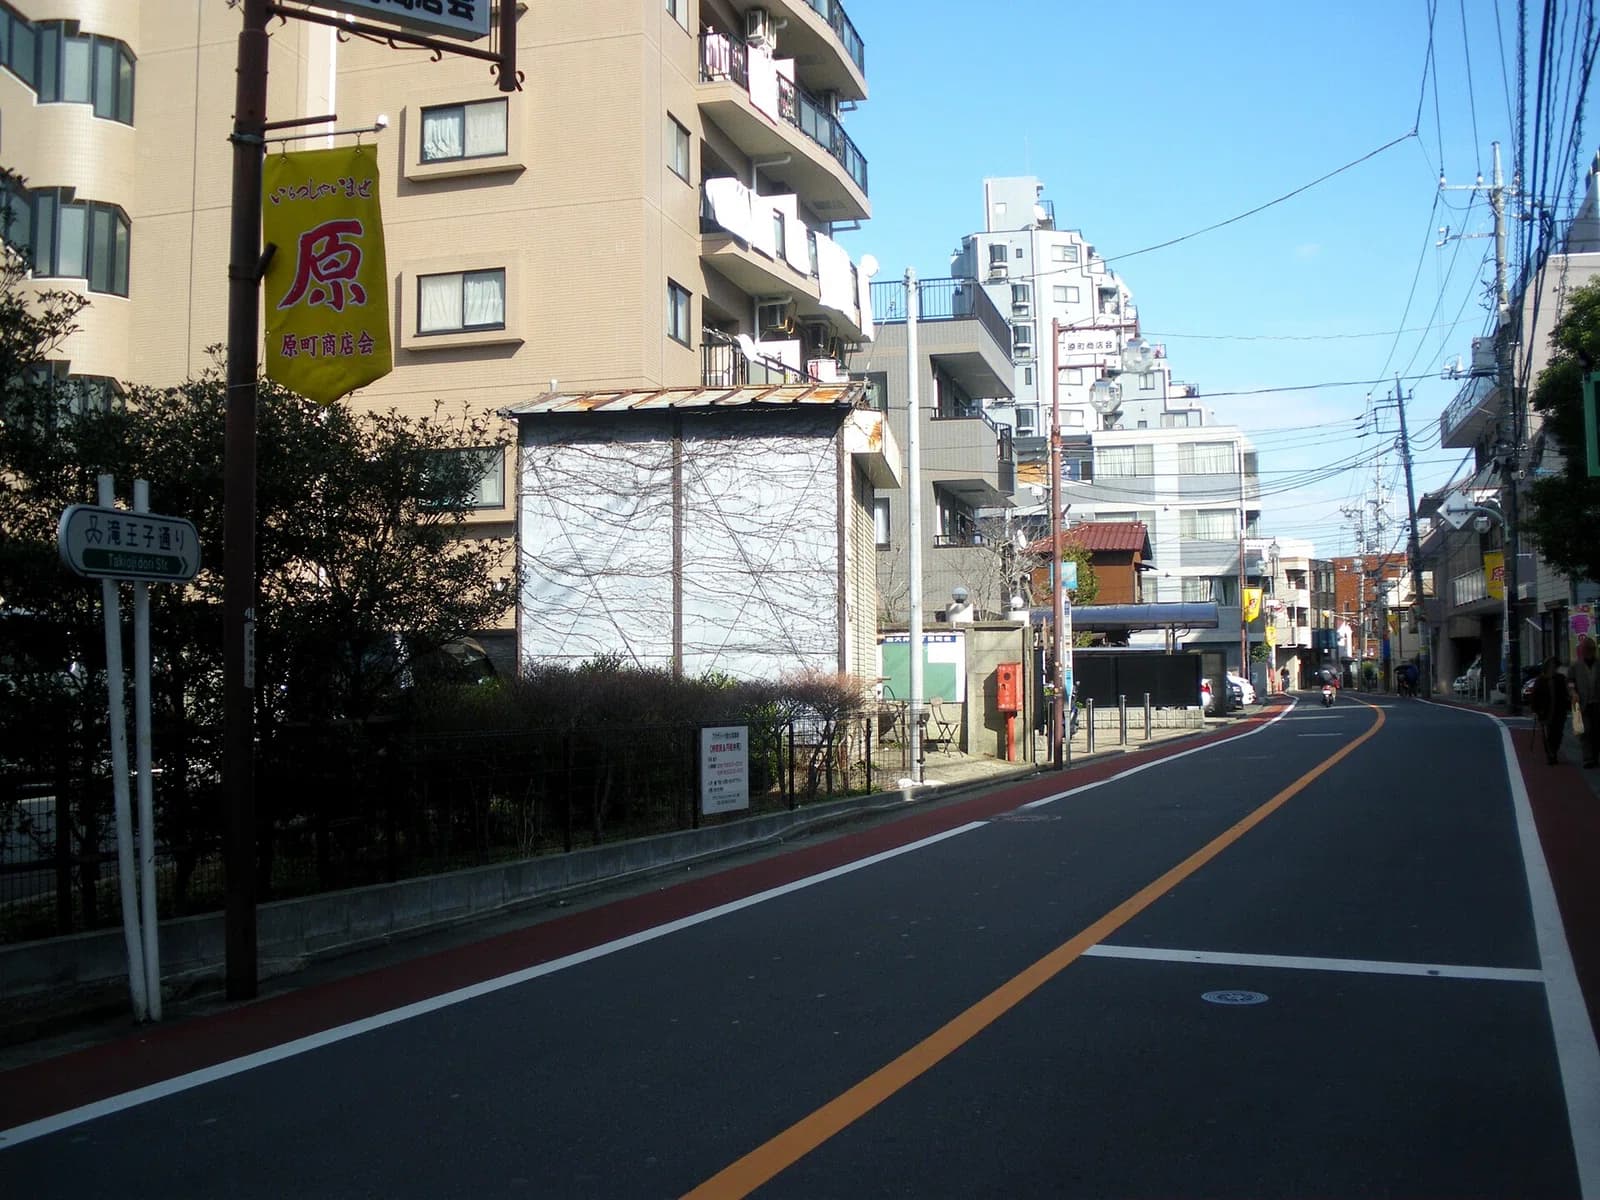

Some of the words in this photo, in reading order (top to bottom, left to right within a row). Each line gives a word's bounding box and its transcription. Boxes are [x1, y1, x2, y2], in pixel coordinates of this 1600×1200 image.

[277, 219, 367, 313] 原
[281, 331, 377, 358] 原町商店会
[107, 520, 184, 552] 滝王子通り
